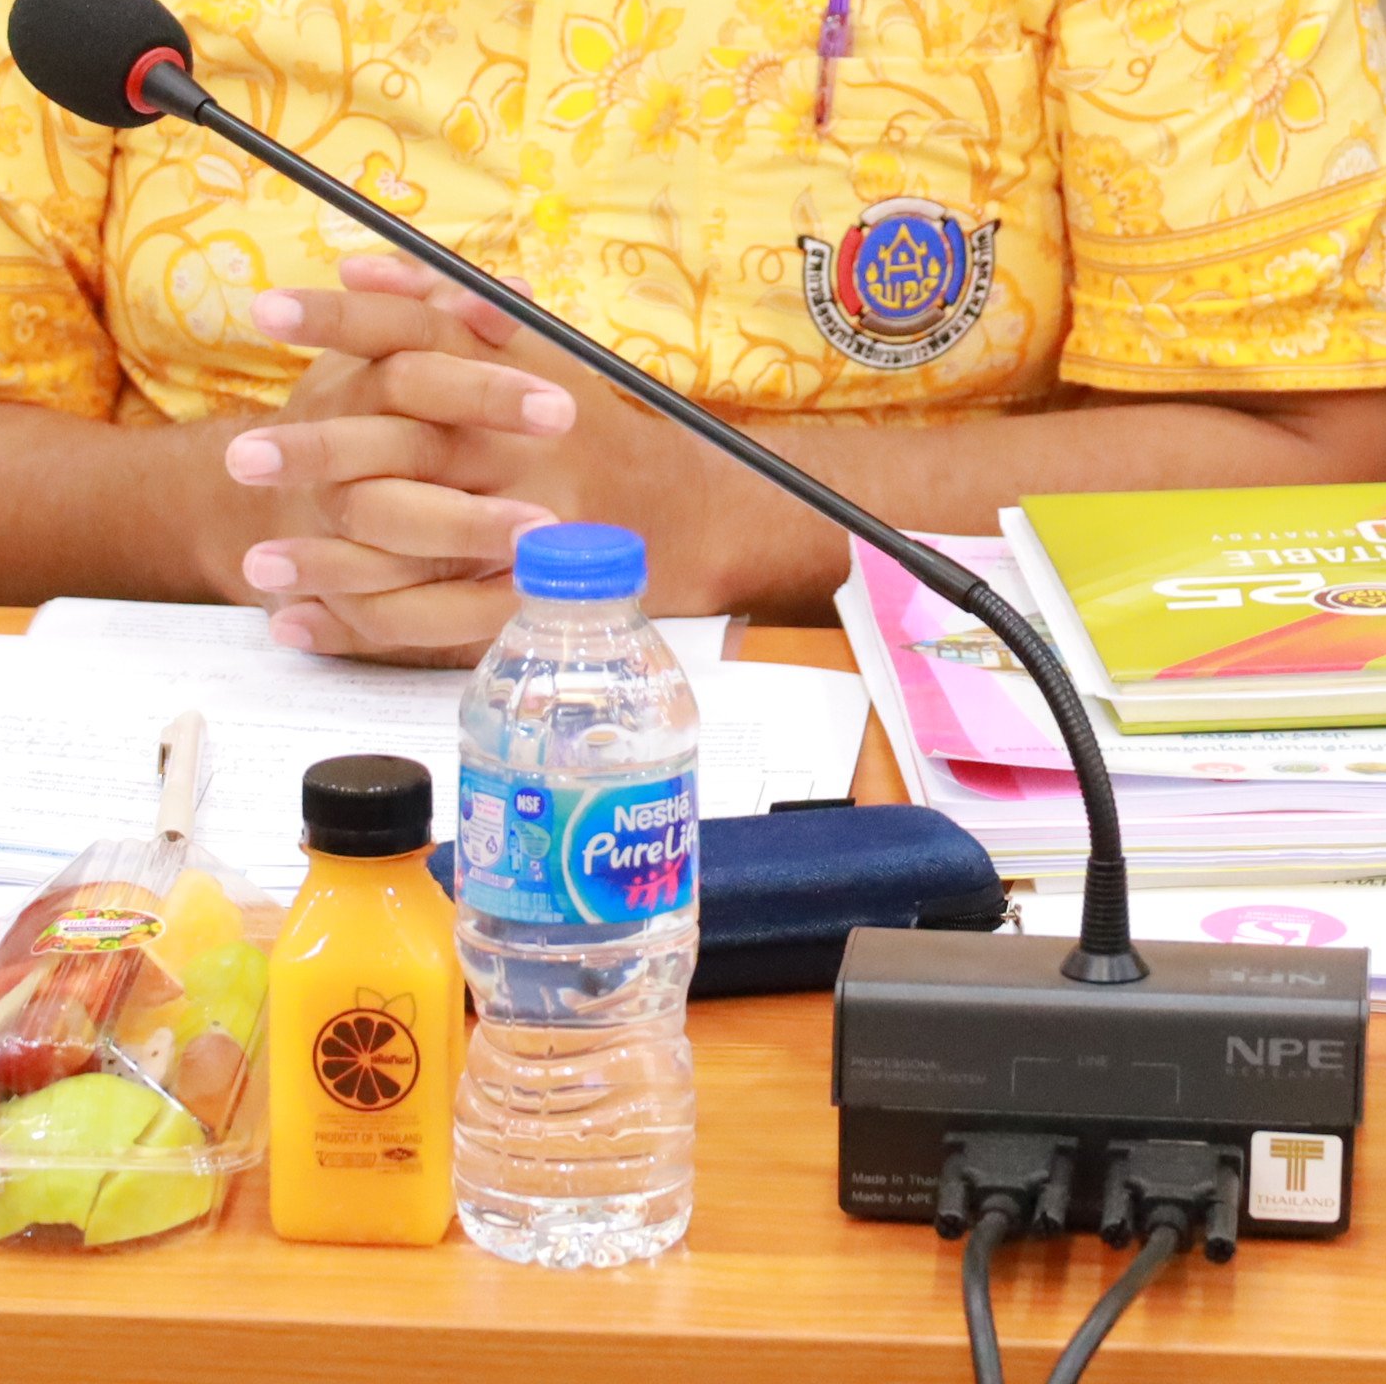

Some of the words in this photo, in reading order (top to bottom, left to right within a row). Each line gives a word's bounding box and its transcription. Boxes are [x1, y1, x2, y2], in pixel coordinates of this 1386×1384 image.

[614, 790, 691, 833] Nestlé
[1225, 1035, 1346, 1069] NPE
[852, 1172, 887, 1185] Made
[851, 1190, 885, 1203] Made
[888, 1192, 903, 1205] by
[1256, 1194, 1336, 1208] THAILAND
